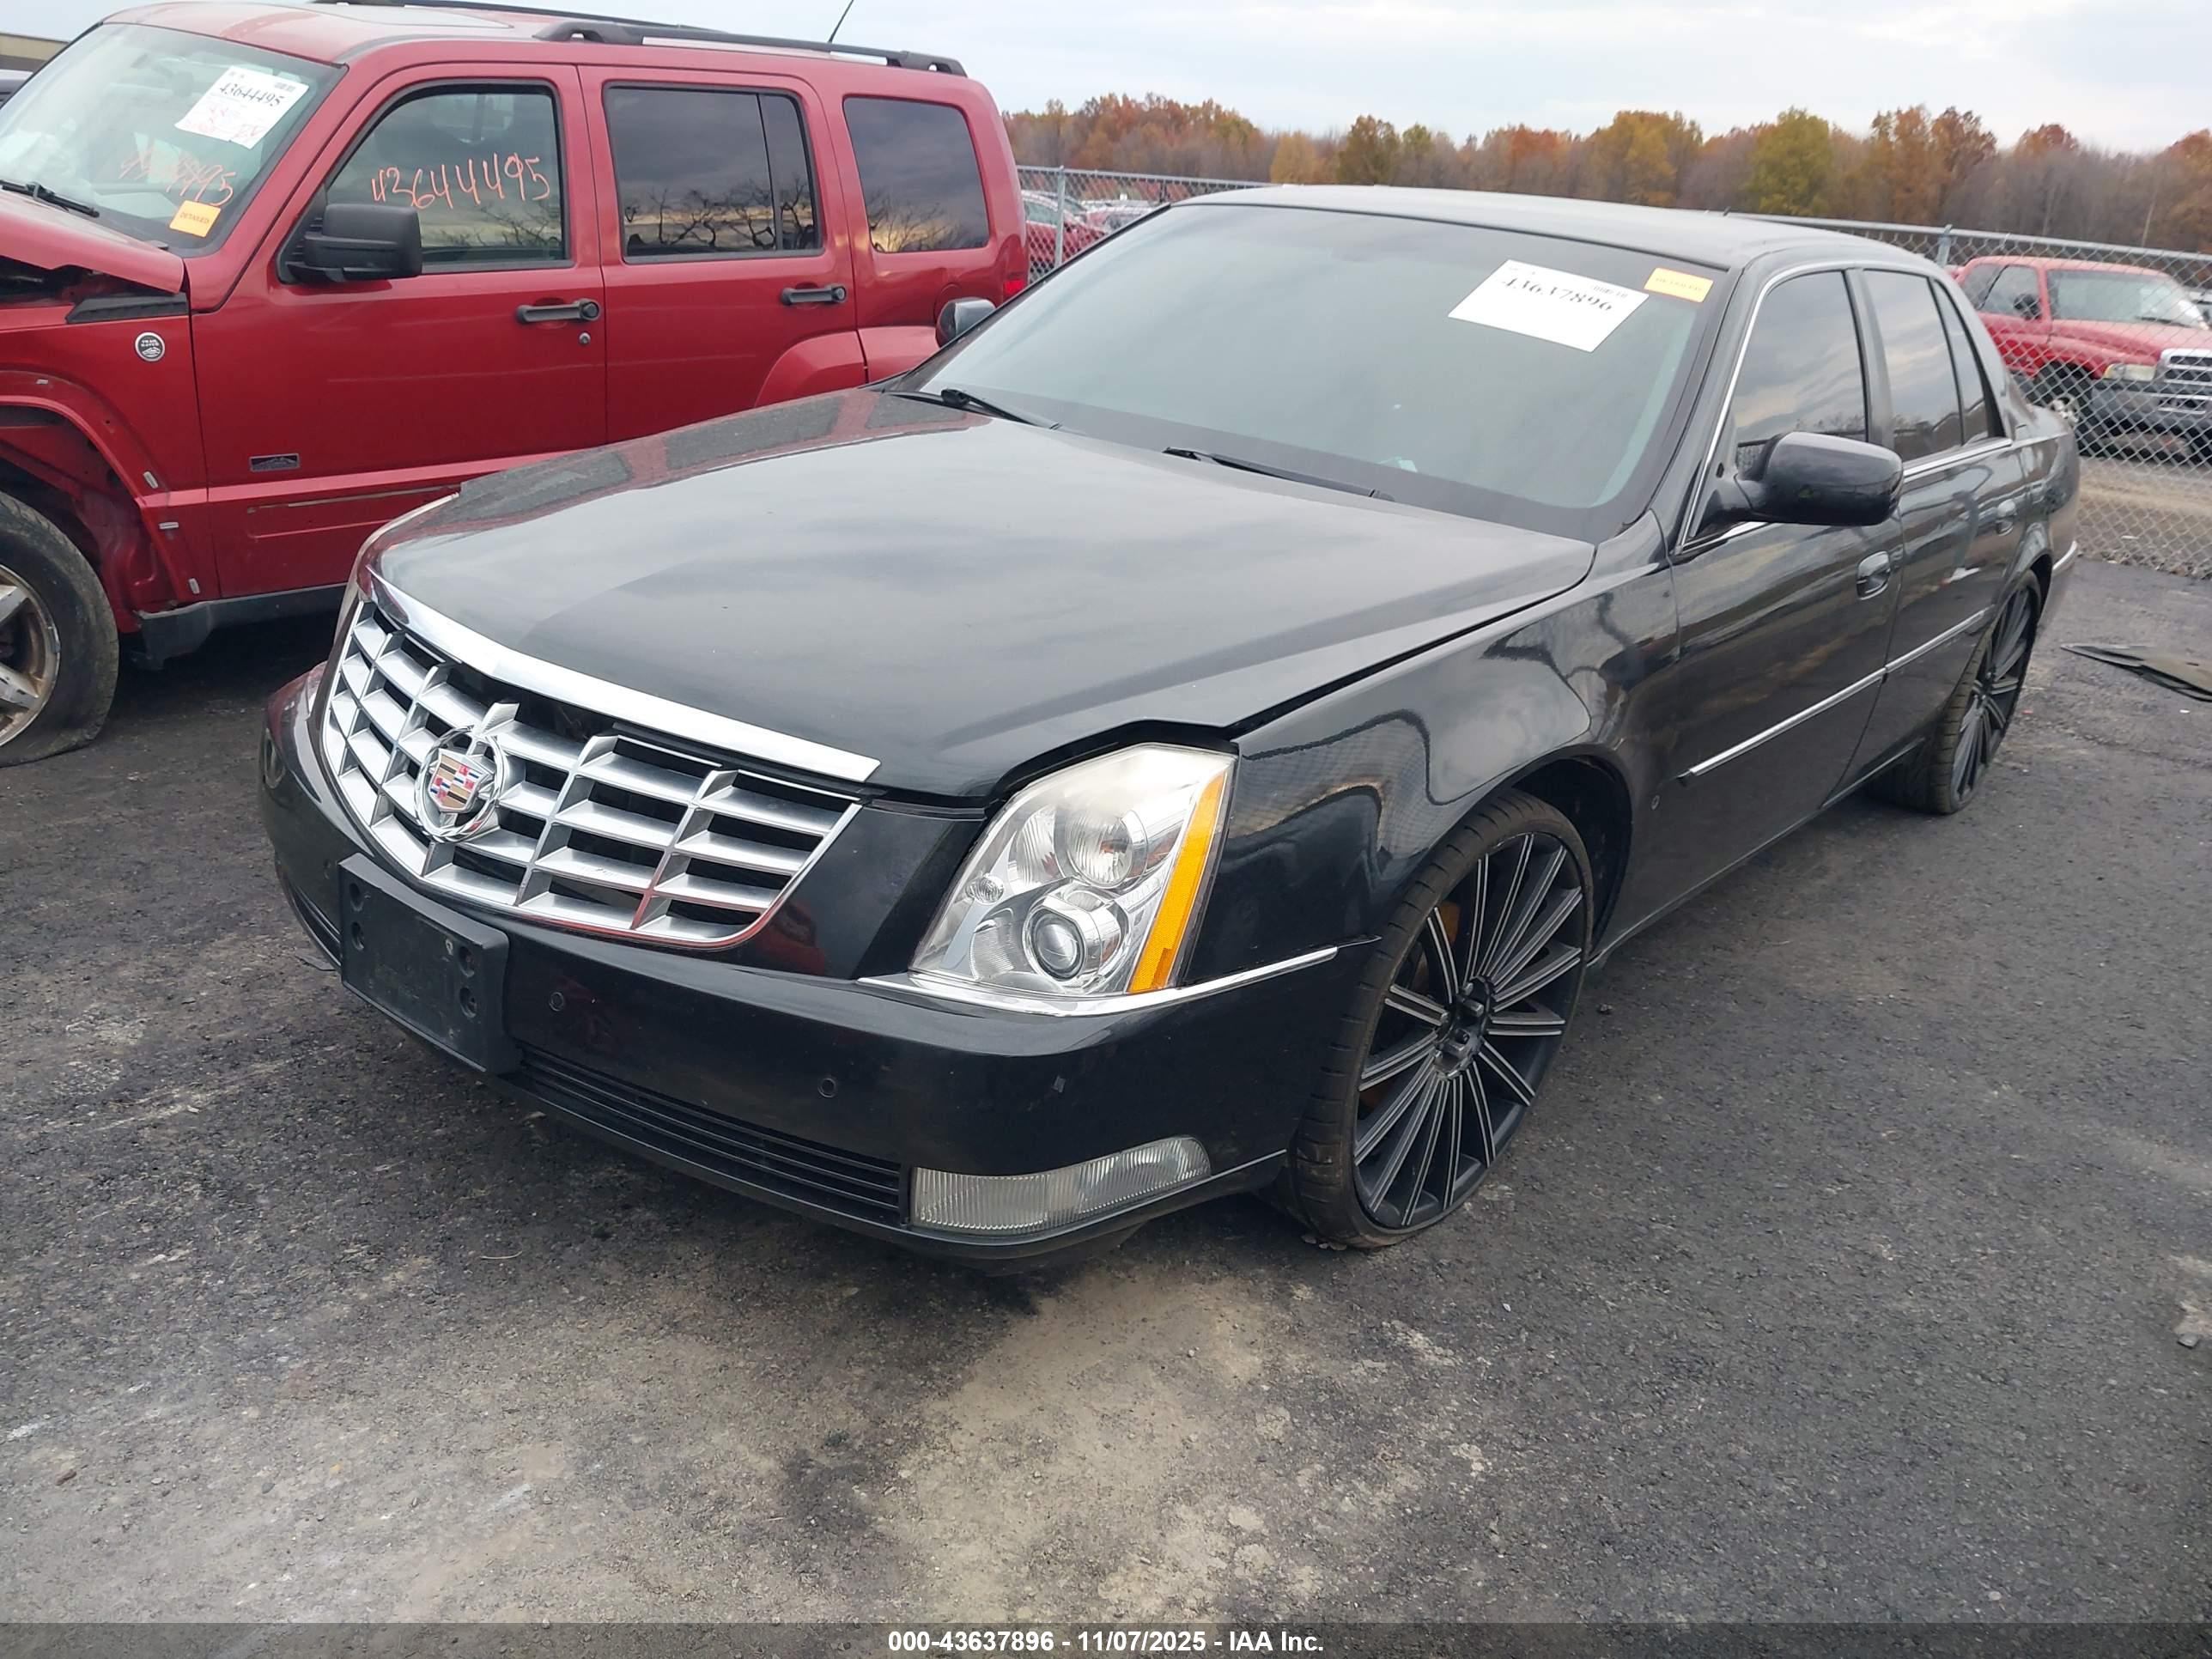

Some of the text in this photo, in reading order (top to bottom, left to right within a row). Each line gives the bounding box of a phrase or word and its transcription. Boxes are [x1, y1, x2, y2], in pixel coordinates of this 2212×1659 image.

[219, 82, 284, 107] 43644495
[371, 152, 550, 209] 43644495
[1502, 276, 1613, 312] 43637896
